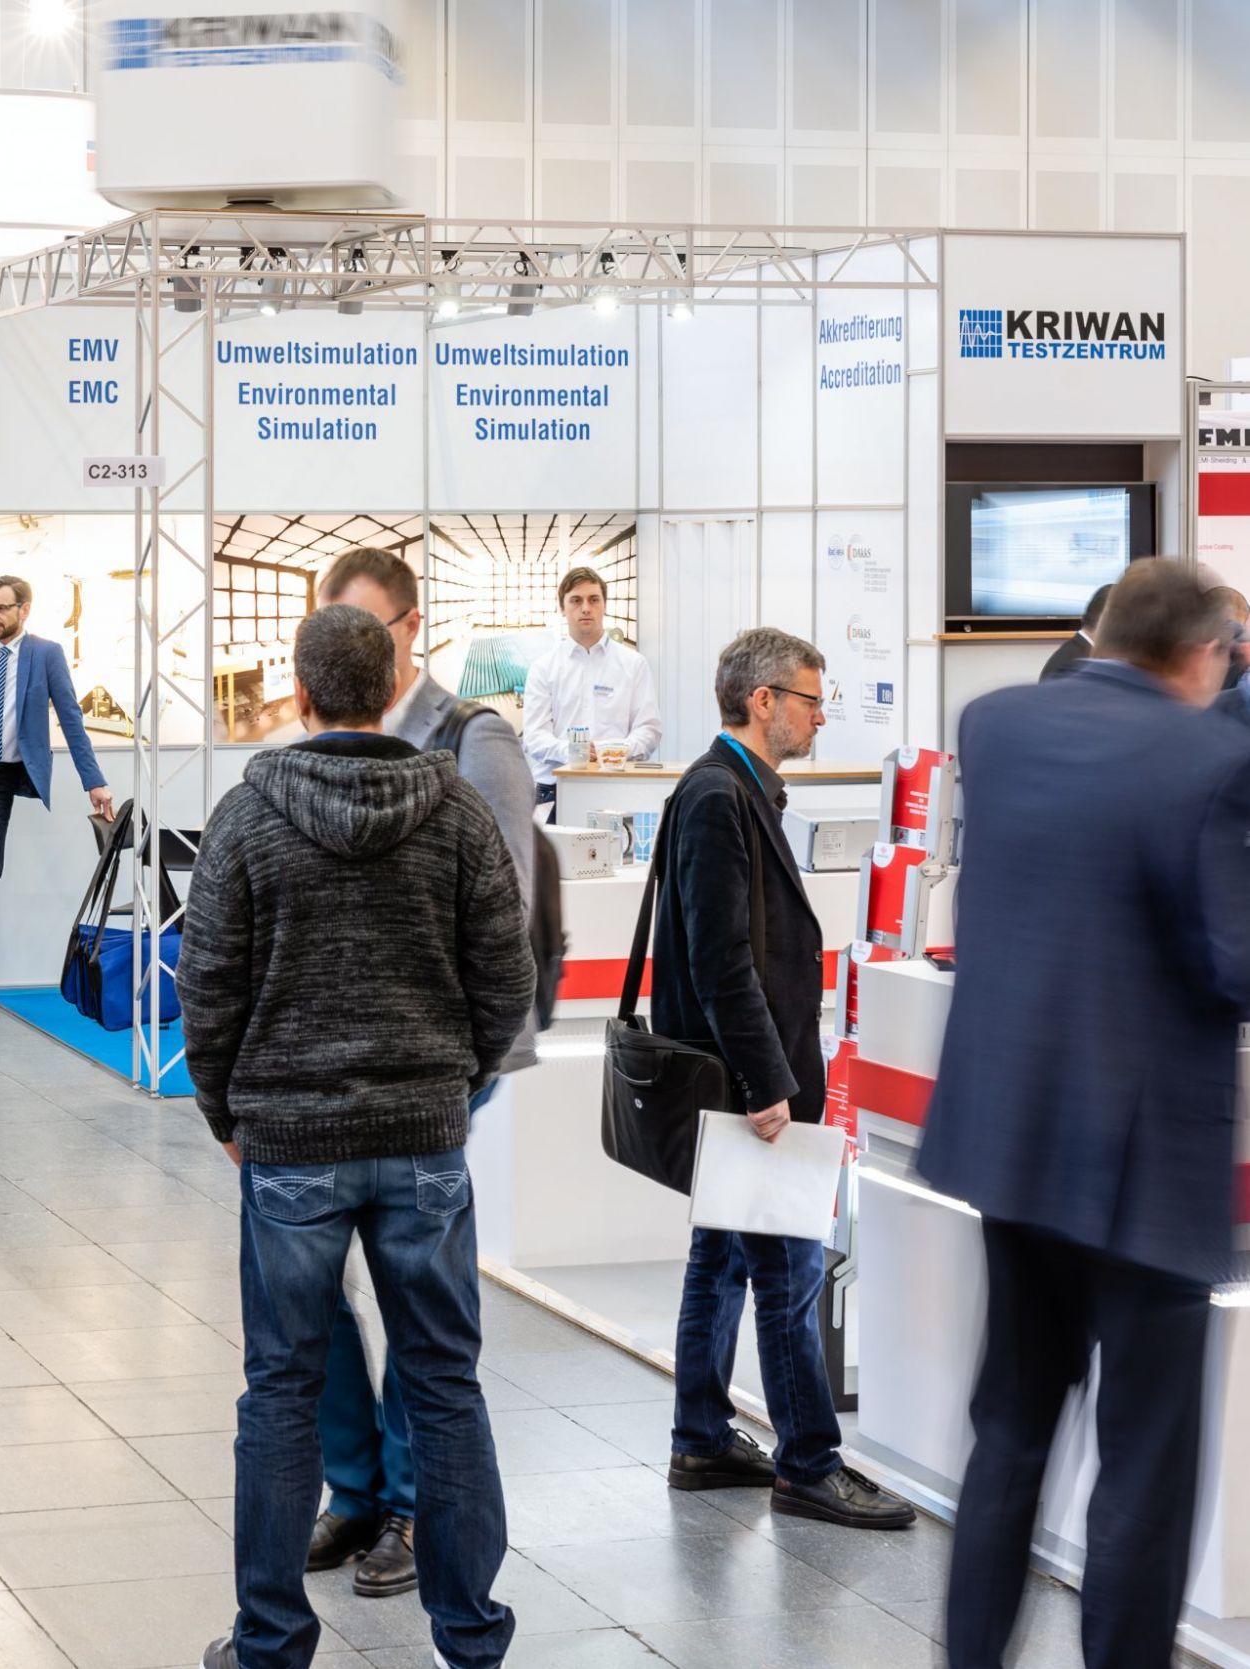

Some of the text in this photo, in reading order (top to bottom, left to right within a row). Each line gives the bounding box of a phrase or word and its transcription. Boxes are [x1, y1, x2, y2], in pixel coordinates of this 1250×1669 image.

[819, 315, 902, 344] Akkreditierung
[1006, 310, 1165, 341] KRIWAN
[68, 339, 119, 362] EMV
[217, 340, 418, 365] Umweltsimulation
[435, 343, 629, 366] Umweltsimulation
[1007, 342, 1165, 360] TESTZENTRUM
[820, 359, 901, 389] Accreditation
[68, 380, 119, 404] EMC
[238, 382, 396, 406] Environmental
[456, 384, 609, 407] Environmental
[257, 416, 378, 441] Simulation
[475, 417, 590, 440] Simulation
[88, 464, 148, 479] C2-313
